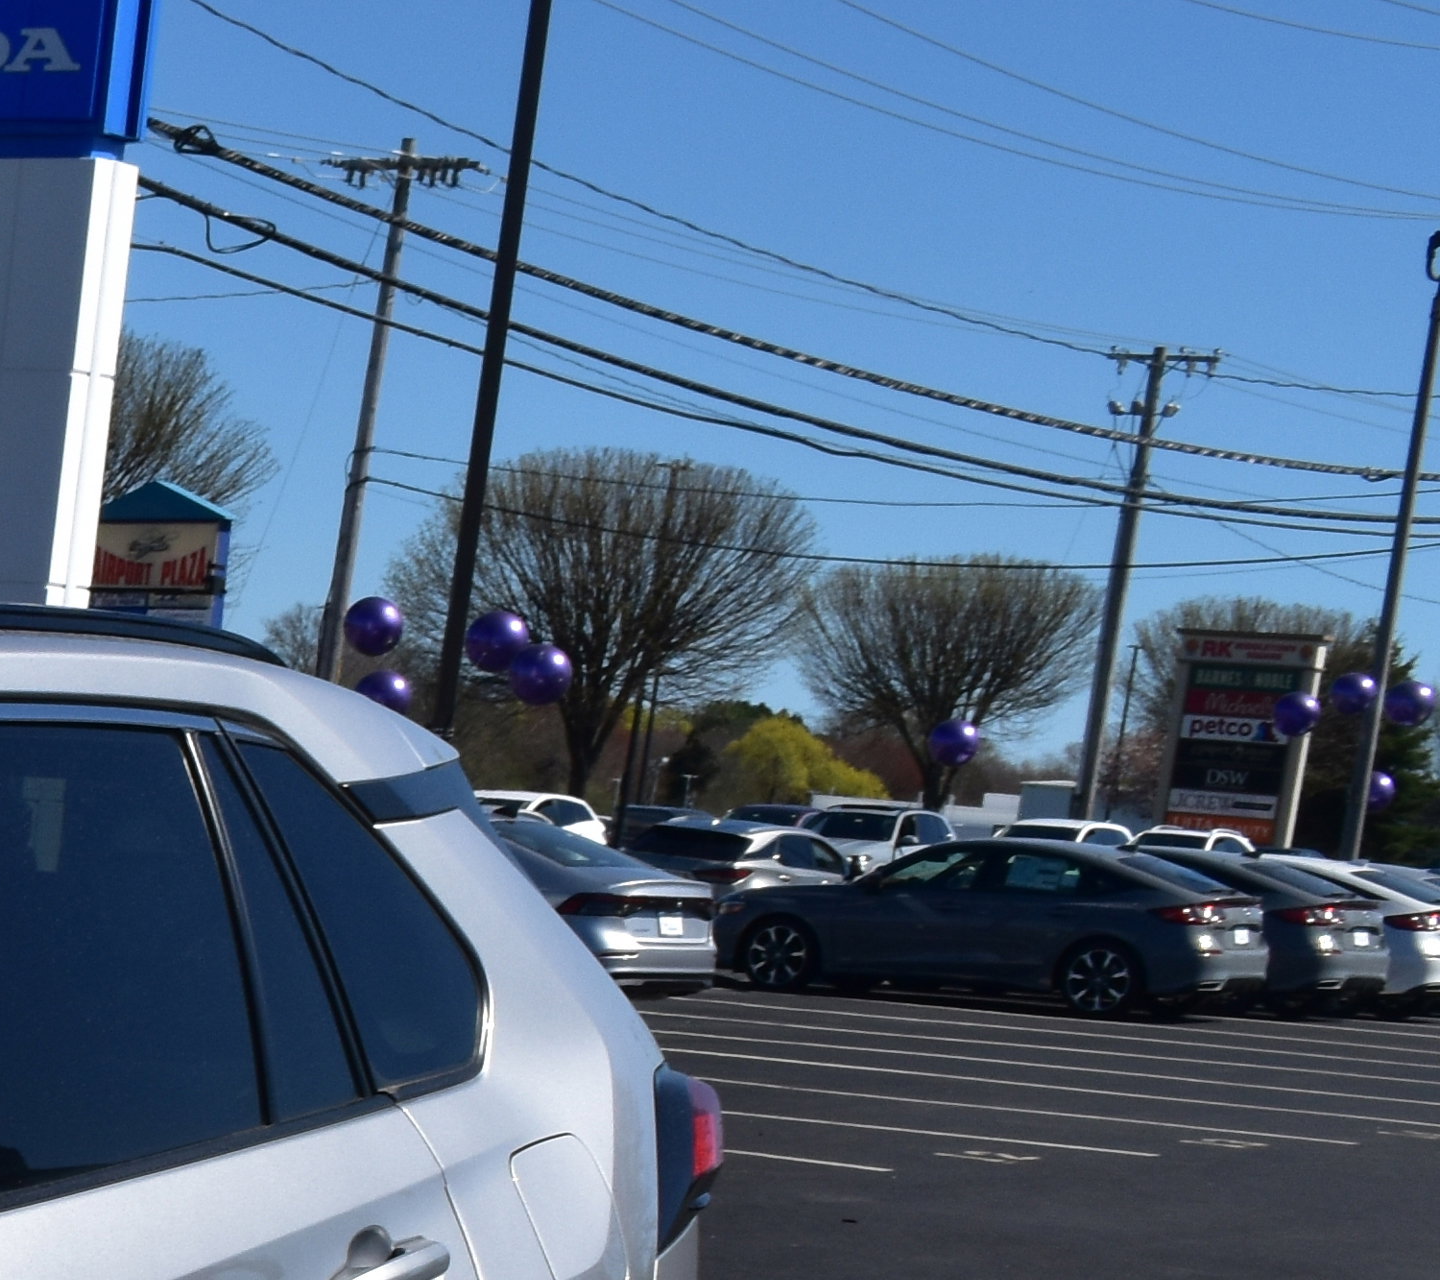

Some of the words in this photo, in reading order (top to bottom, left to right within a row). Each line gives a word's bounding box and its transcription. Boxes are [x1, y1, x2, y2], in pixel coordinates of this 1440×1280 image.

[93, 546, 152, 585] AIRPORT
[161, 547, 207, 586] PLAZA
[1202, 640, 1233, 657] RK
[1190, 717, 1253, 738] petco
[1205, 768, 1249, 785] DSW
